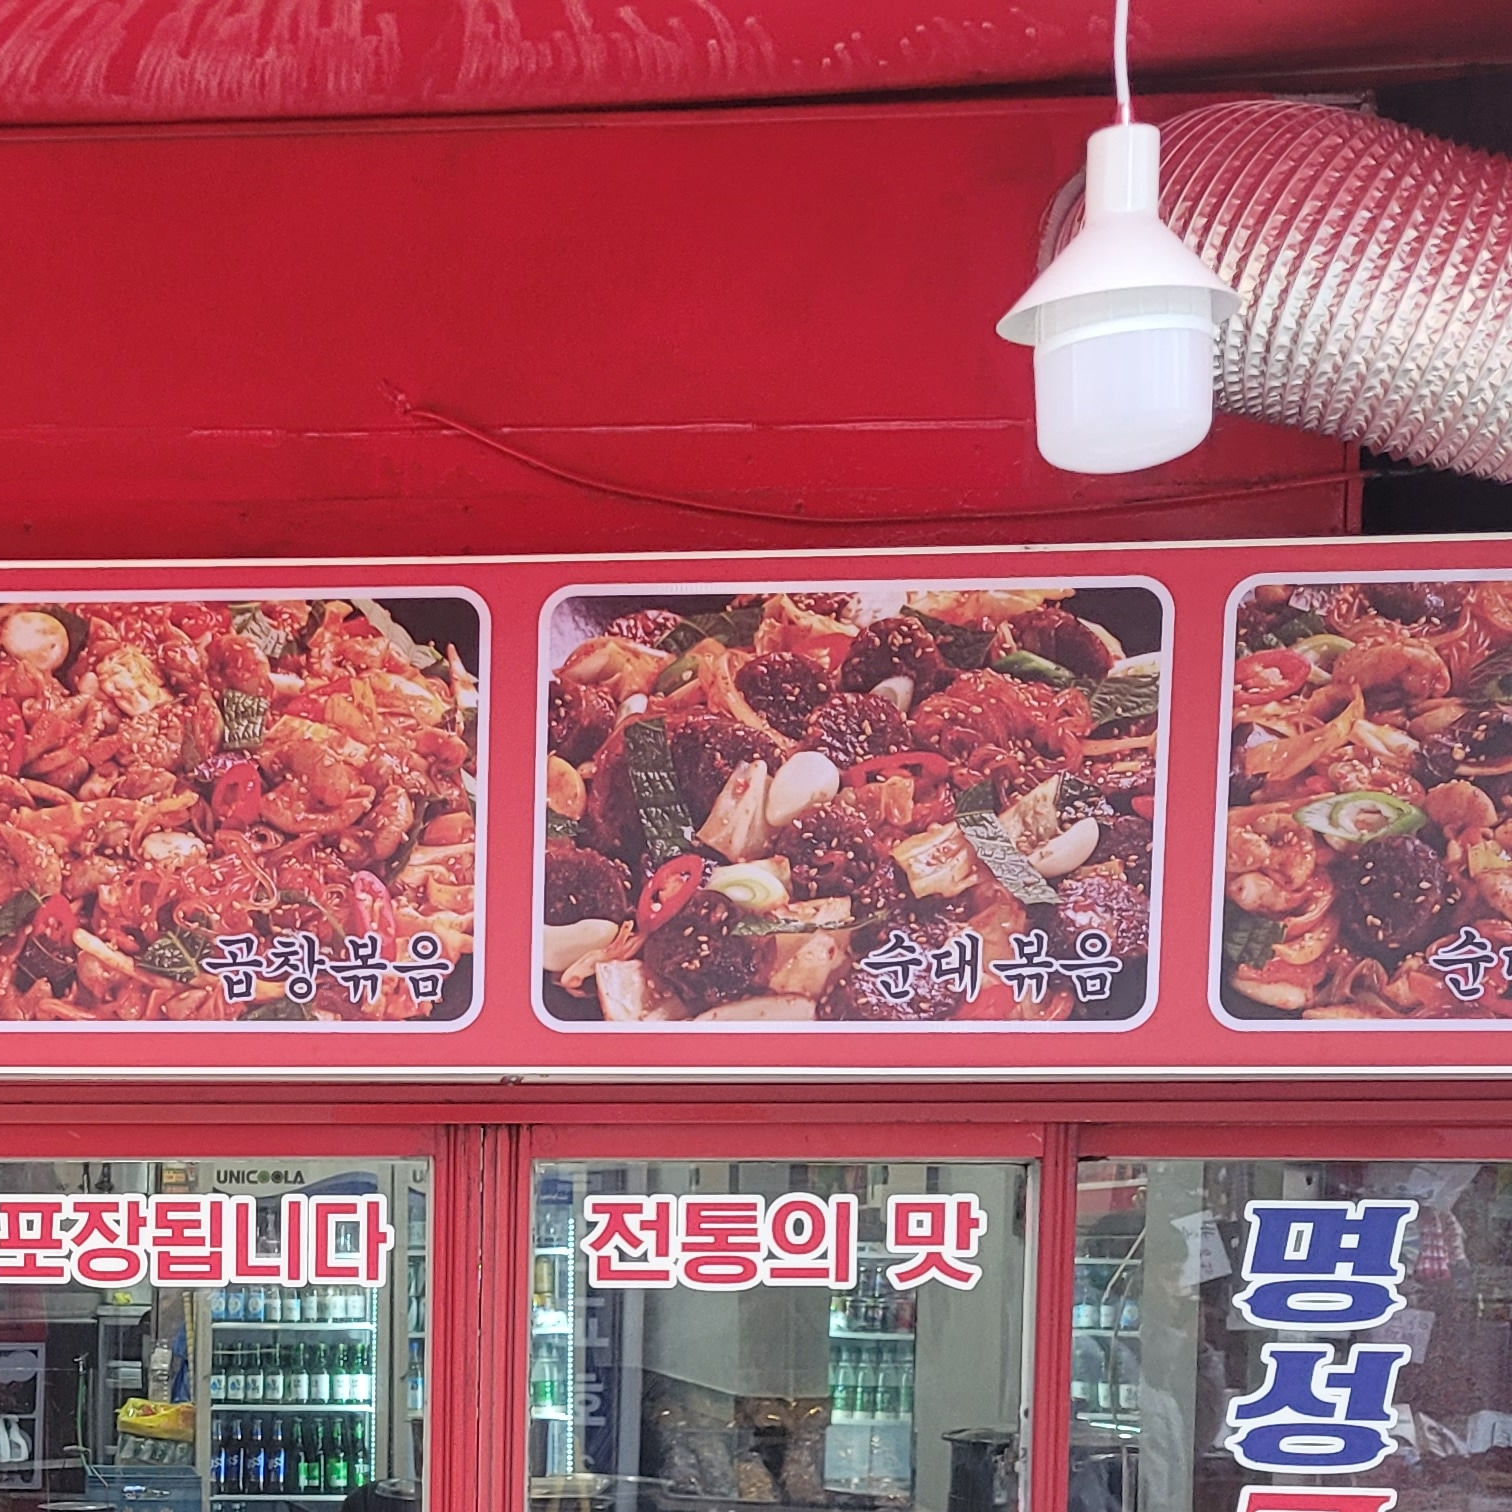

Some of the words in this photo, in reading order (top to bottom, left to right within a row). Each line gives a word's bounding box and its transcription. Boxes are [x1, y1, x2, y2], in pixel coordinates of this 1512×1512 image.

[201, 930, 455, 1004] 곱창볶음
[860, 928, 1123, 1004] 순대볶음
[1430, 927, 1512, 1000] 순
[581, 1192, 858, 1290] 전통의
[886, 1192, 987, 1291] 맛
